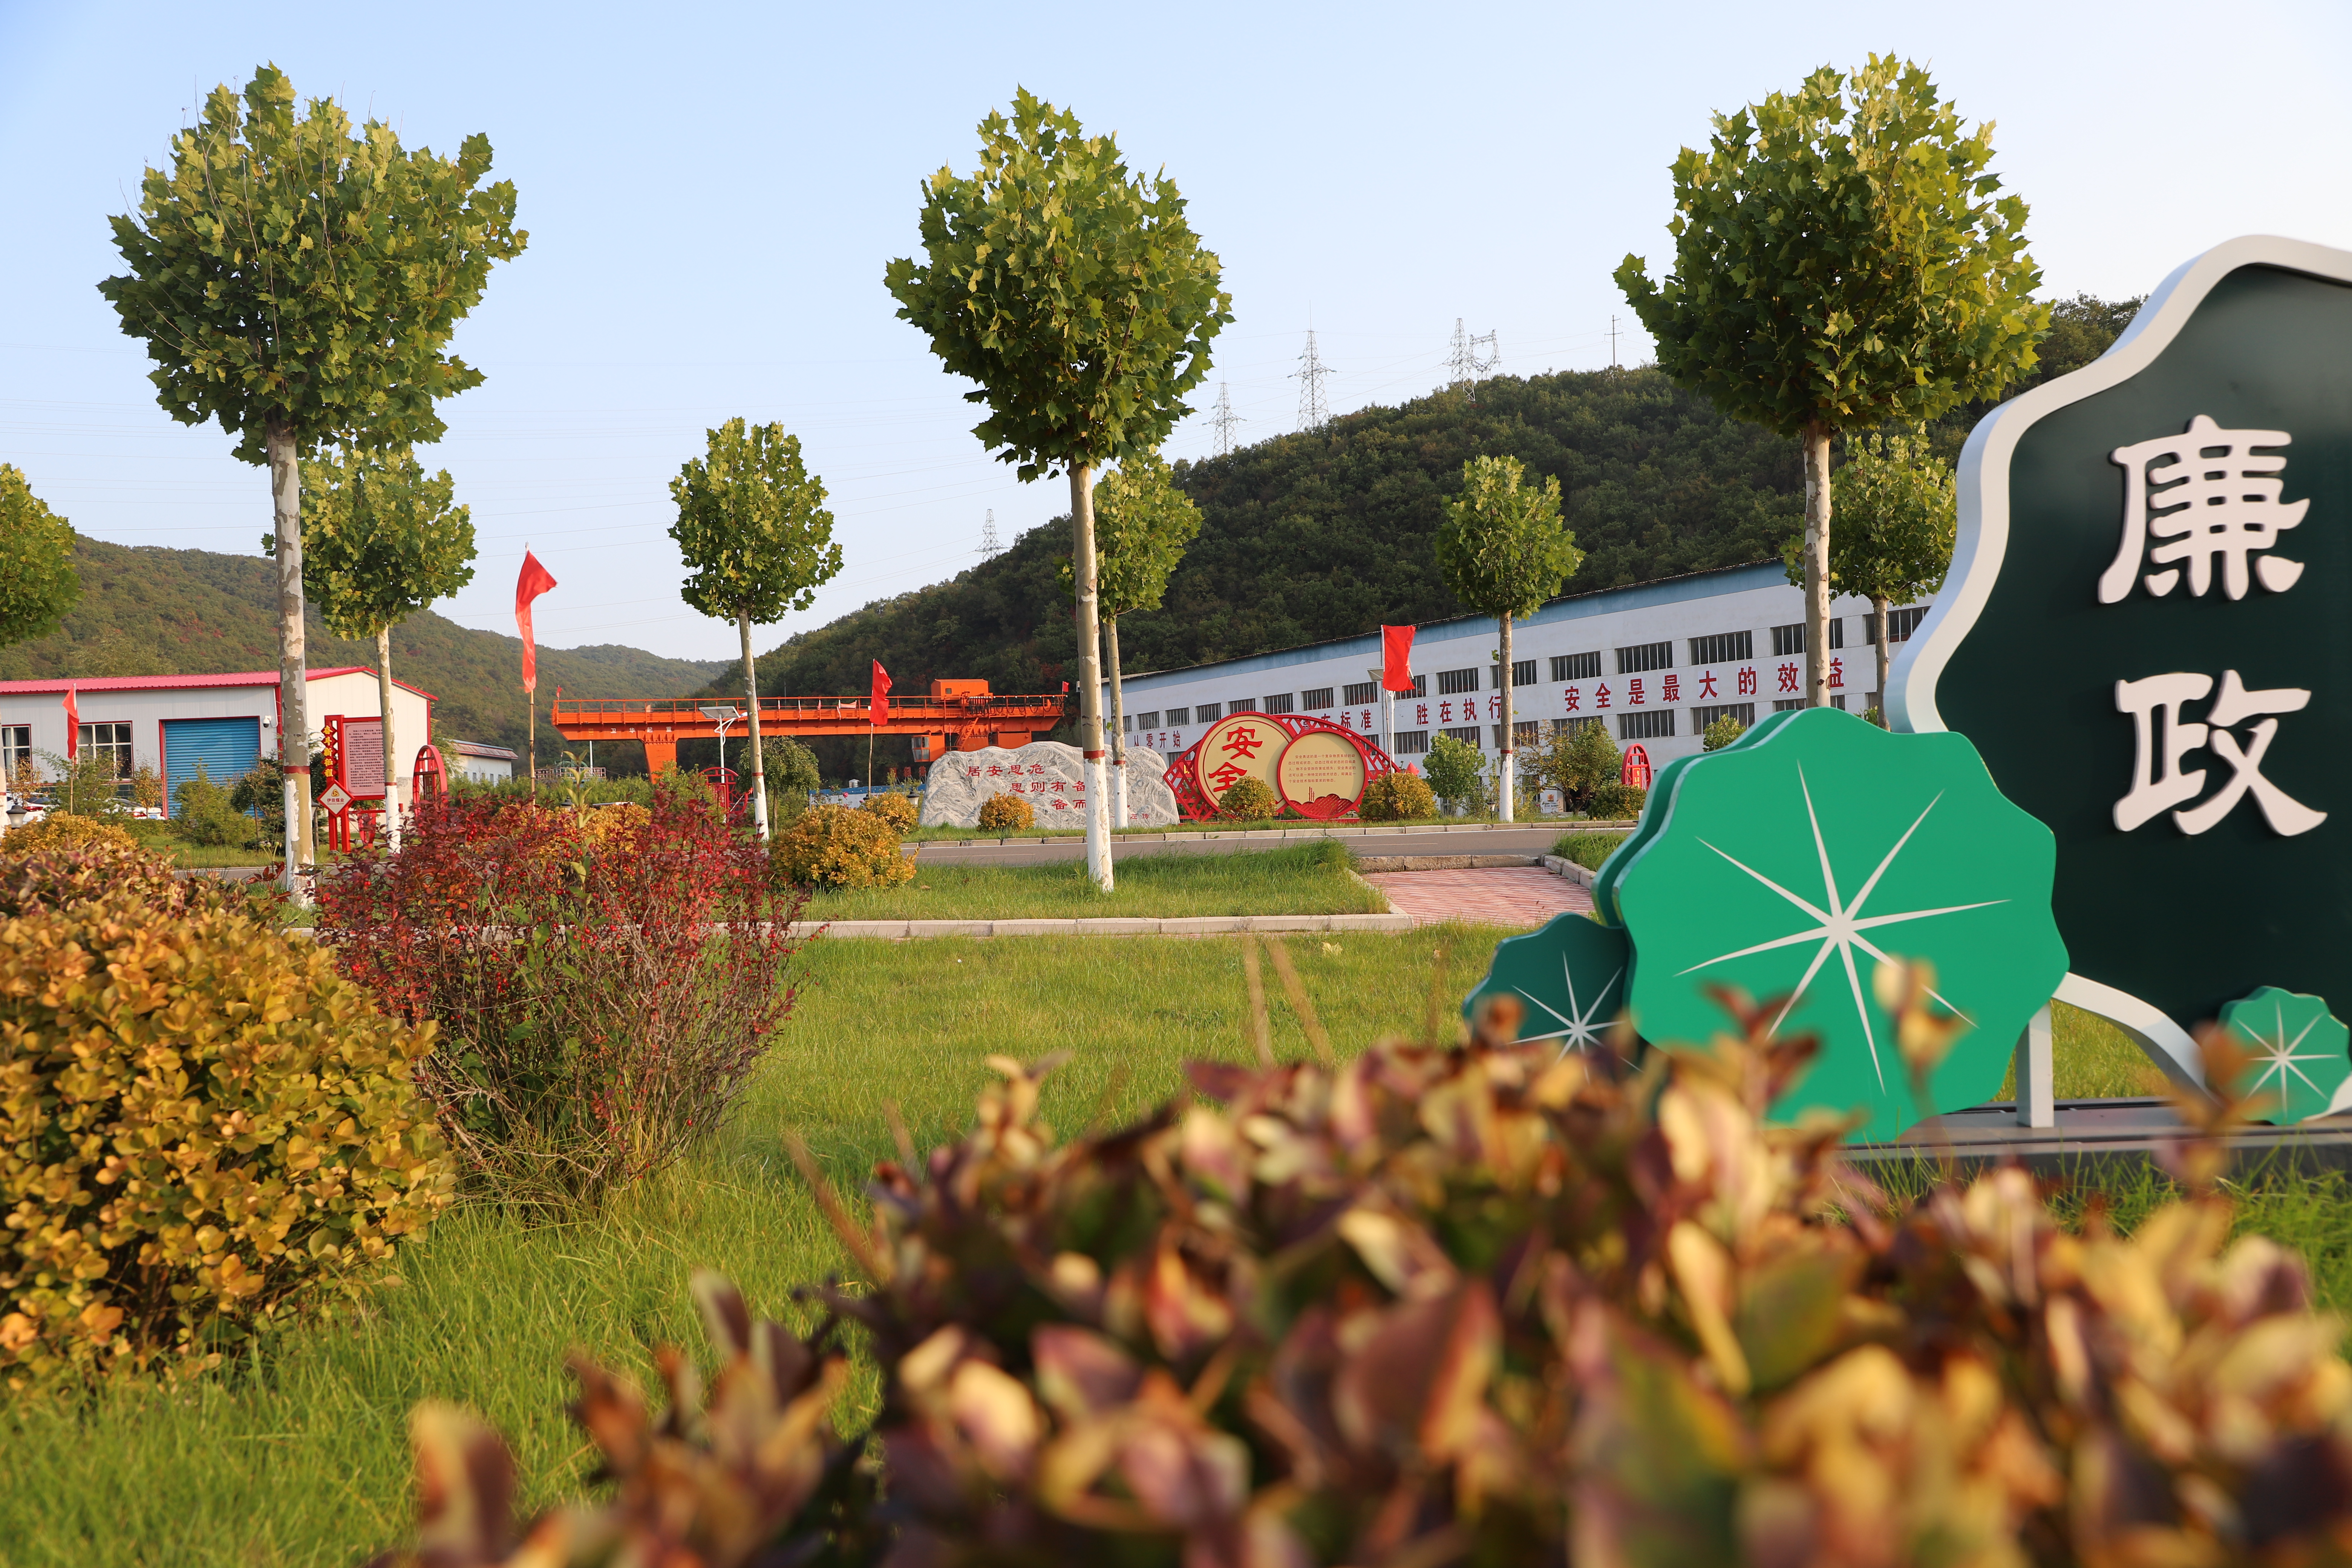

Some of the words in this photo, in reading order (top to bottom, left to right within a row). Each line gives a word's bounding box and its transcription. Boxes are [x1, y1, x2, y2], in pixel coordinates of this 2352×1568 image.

[2099, 415, 2328, 836] 廉政
[1564, 657, 1844, 714] 安全是最大的效益
[1416, 696, 1501, 726] 胜在执行
[1134, 730, 1181, 749] 从零开始
[966, 763, 1045, 778] 居安思危
[1208, 726, 1263, 792] 安全
[1009, 781, 1085, 793] 思则有备
